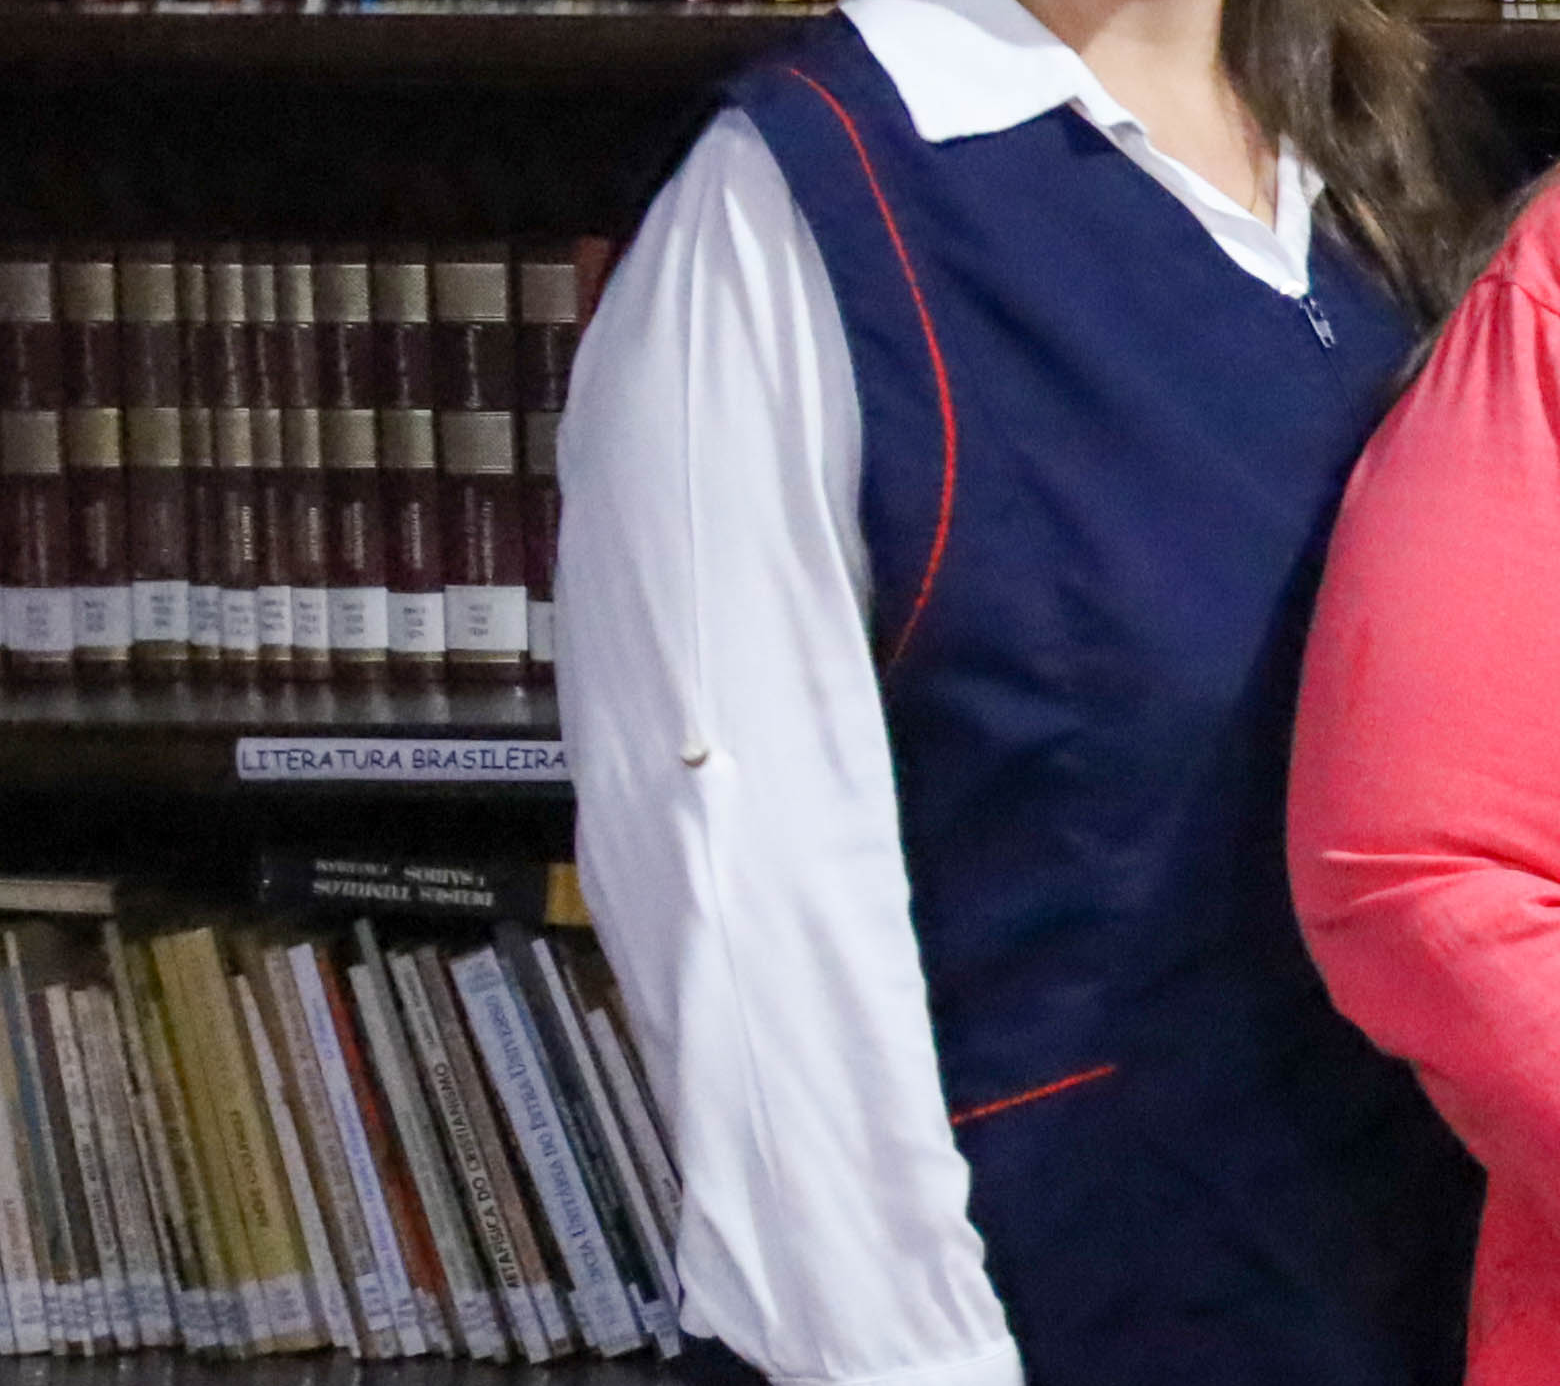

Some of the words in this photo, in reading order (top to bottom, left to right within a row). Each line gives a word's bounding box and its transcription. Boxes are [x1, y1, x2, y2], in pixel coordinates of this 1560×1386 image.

[242, 748, 400, 771] LITERATURA
[411, 748, 566, 769] BRASILEIRA
[430, 1061, 482, 1174] CRISTIANISMO
[470, 1175, 491, 1202] DO
